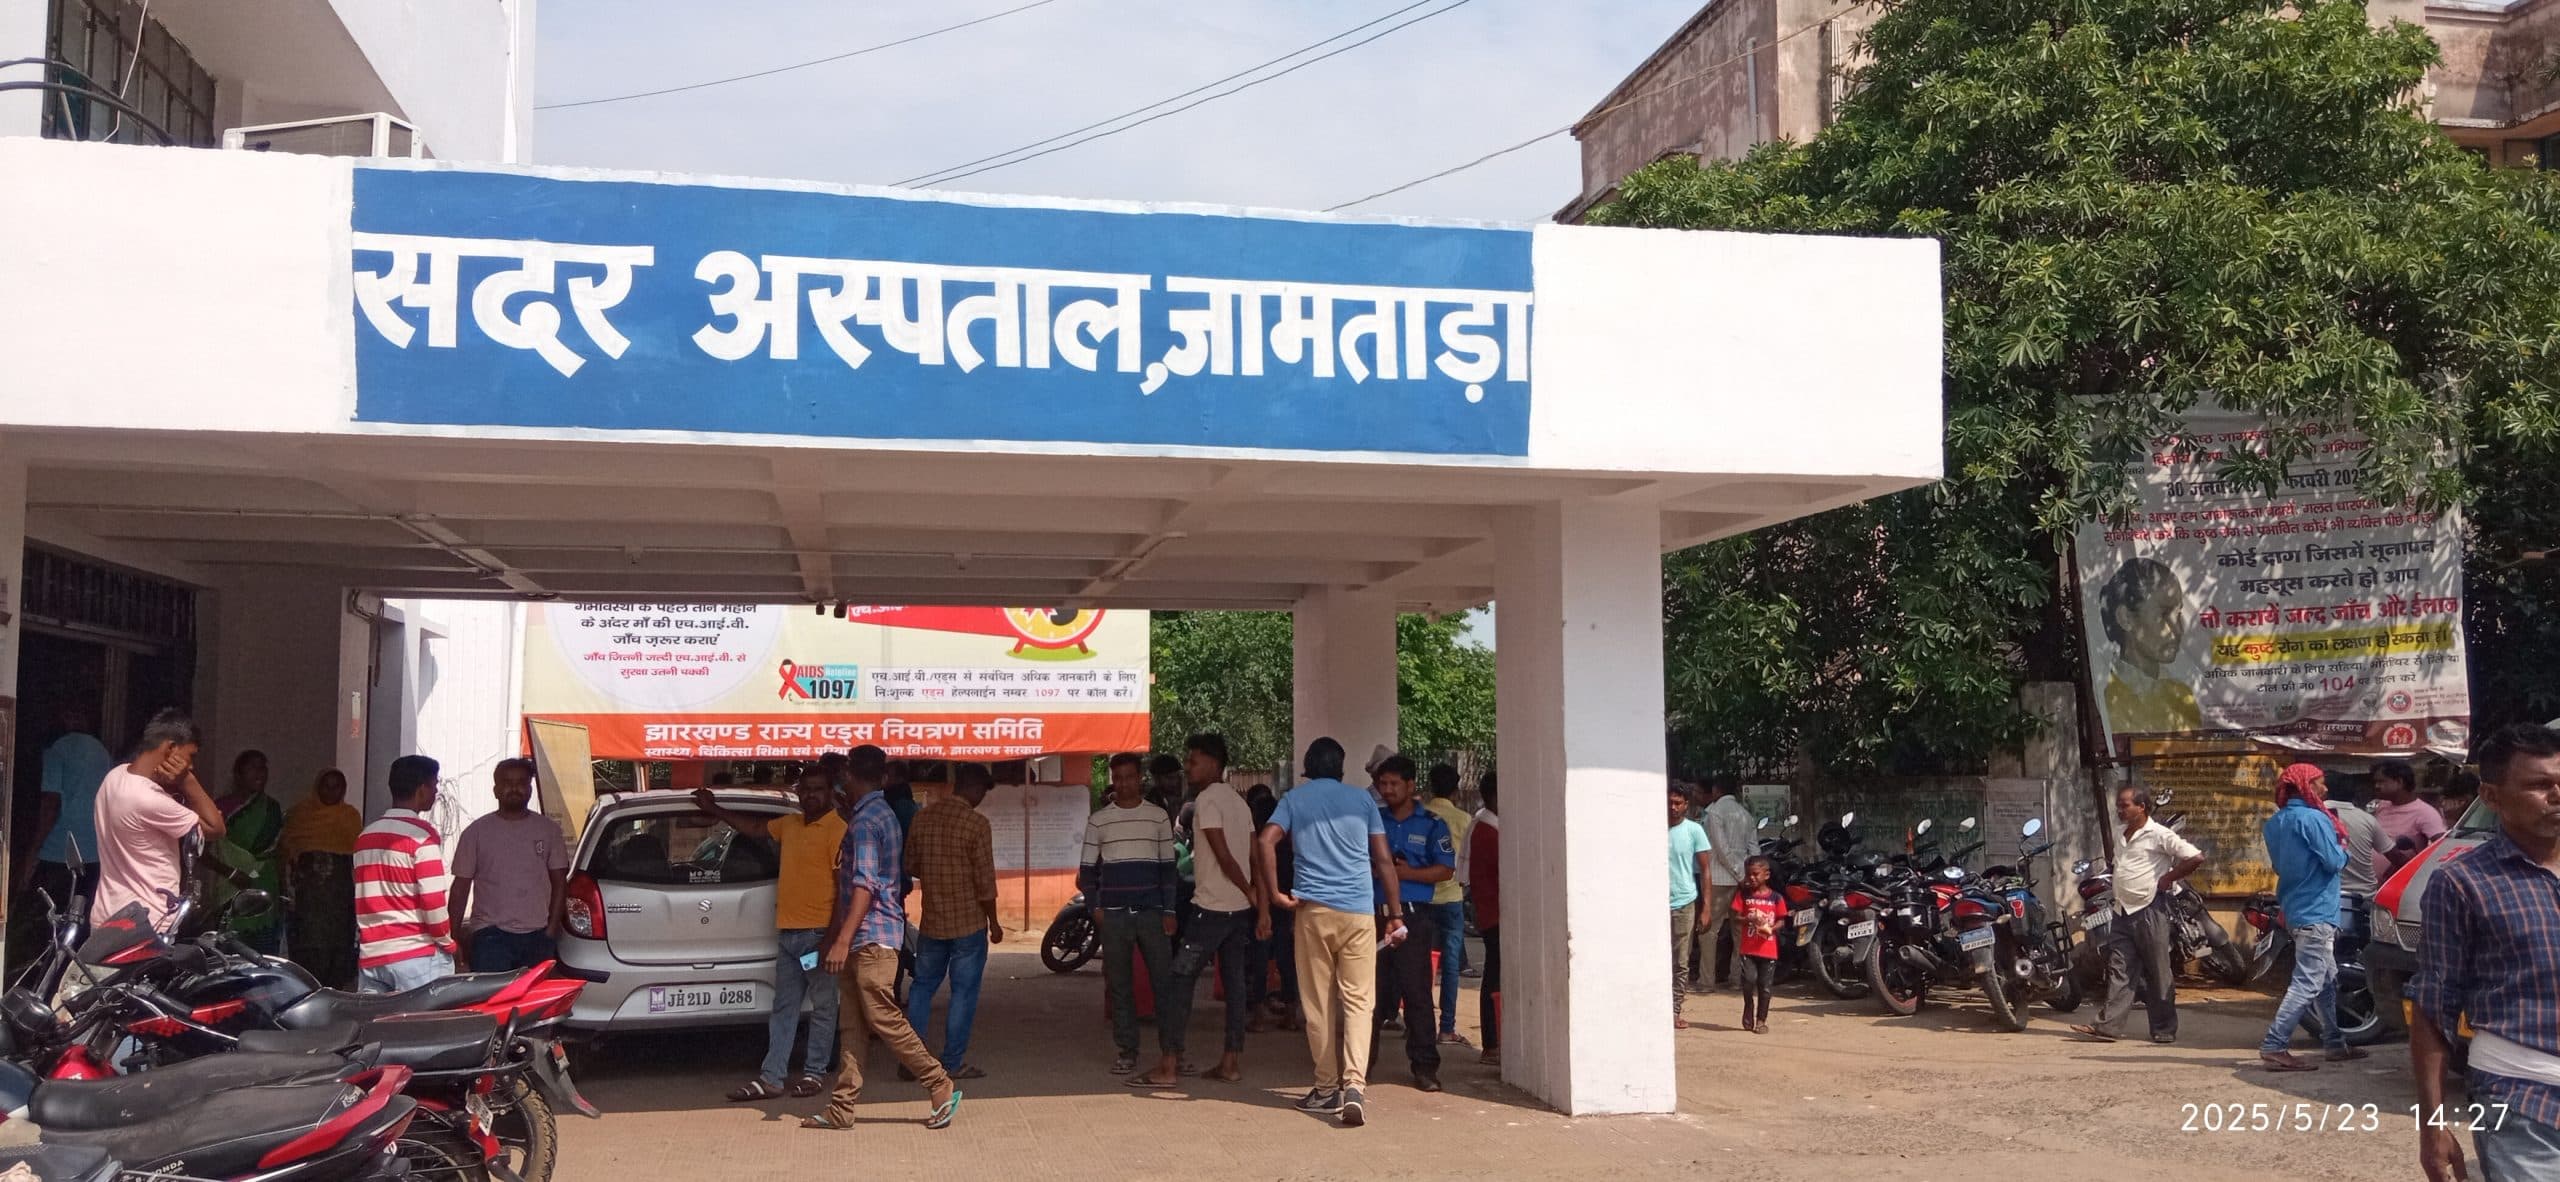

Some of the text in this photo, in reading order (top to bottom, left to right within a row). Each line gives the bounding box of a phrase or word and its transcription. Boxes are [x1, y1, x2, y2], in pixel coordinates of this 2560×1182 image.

[352, 231, 655, 378] सदर
[2166, 482, 2184, 497] 30
[2302, 502, 2333, 514] गलत
[2302, 519, 2327, 534] कोई
[2330, 516, 2345, 531] भी
[2217, 539, 2435, 568] कोई दाग जिसमें सूनापन
[2239, 566, 2420, 596] महसूस करते हो आप
[2199, 605, 2220, 628] तो
[2225, 602, 2280, 628] करायें
[2284, 606, 2326, 624] जल्द
[2330, 597, 2371, 621] जाँच
[2377, 593, 2407, 618] और
[581, 615, 750, 630] के अंदर माँ की एच.आई.वी.
[613, 632, 641, 645] जाँच
[684, 633, 720, 646] कराएं
[2216, 644, 2239, 656] यह
[2278, 638, 2304, 654] रोग
[2308, 638, 2328, 651] का
[2332, 636, 2372, 650] लक्षण
[583, 651, 746, 663] जाँच जितनी जल्दी एच.आई.वी. से
[620, 666, 709, 679] सुरक्षा उतनी पक्की
[797, 665, 824, 678] AIDS
[963, 669, 972, 681] से
[1022, 669, 1051, 681] अधिक
[1057, 669, 1097, 681] जानकारी
[1103, 670, 1112, 681] के
[1118, 670, 1137, 683] लिए
[2205, 667, 2238, 679] अधिक
[2241, 664, 2287, 677] जानकारी
[2304, 662, 2325, 674] लिए
[809, 679, 855, 699] 1097
[1002, 688, 1027, 697] नम्बर
[1035, 688, 1060, 697] 1097
[1067, 688, 1080, 697] पर
[1087, 686, 1107, 697] कॉल
[2320, 675, 2355, 692] 104
[644, 723, 752, 743] झारखण्ड
[757, 723, 815, 741] राज्य
[818, 723, 875, 745] एड्स
[971, 717, 1045, 740] समिति
[699, 744, 753, 758] चिकित्सा
[756, 744, 789, 757] शिक्षा
[792, 744, 811, 757] एवं
[907, 743, 946, 757] विभाग,
[951, 744, 1000, 756] झारखण्ड
[1003, 744, 1044, 756] सरकार
[668, 993, 685, 1007] JH
[720, 989, 752, 1005] 0288
[152, 1160, 185, 1175] ONDA
